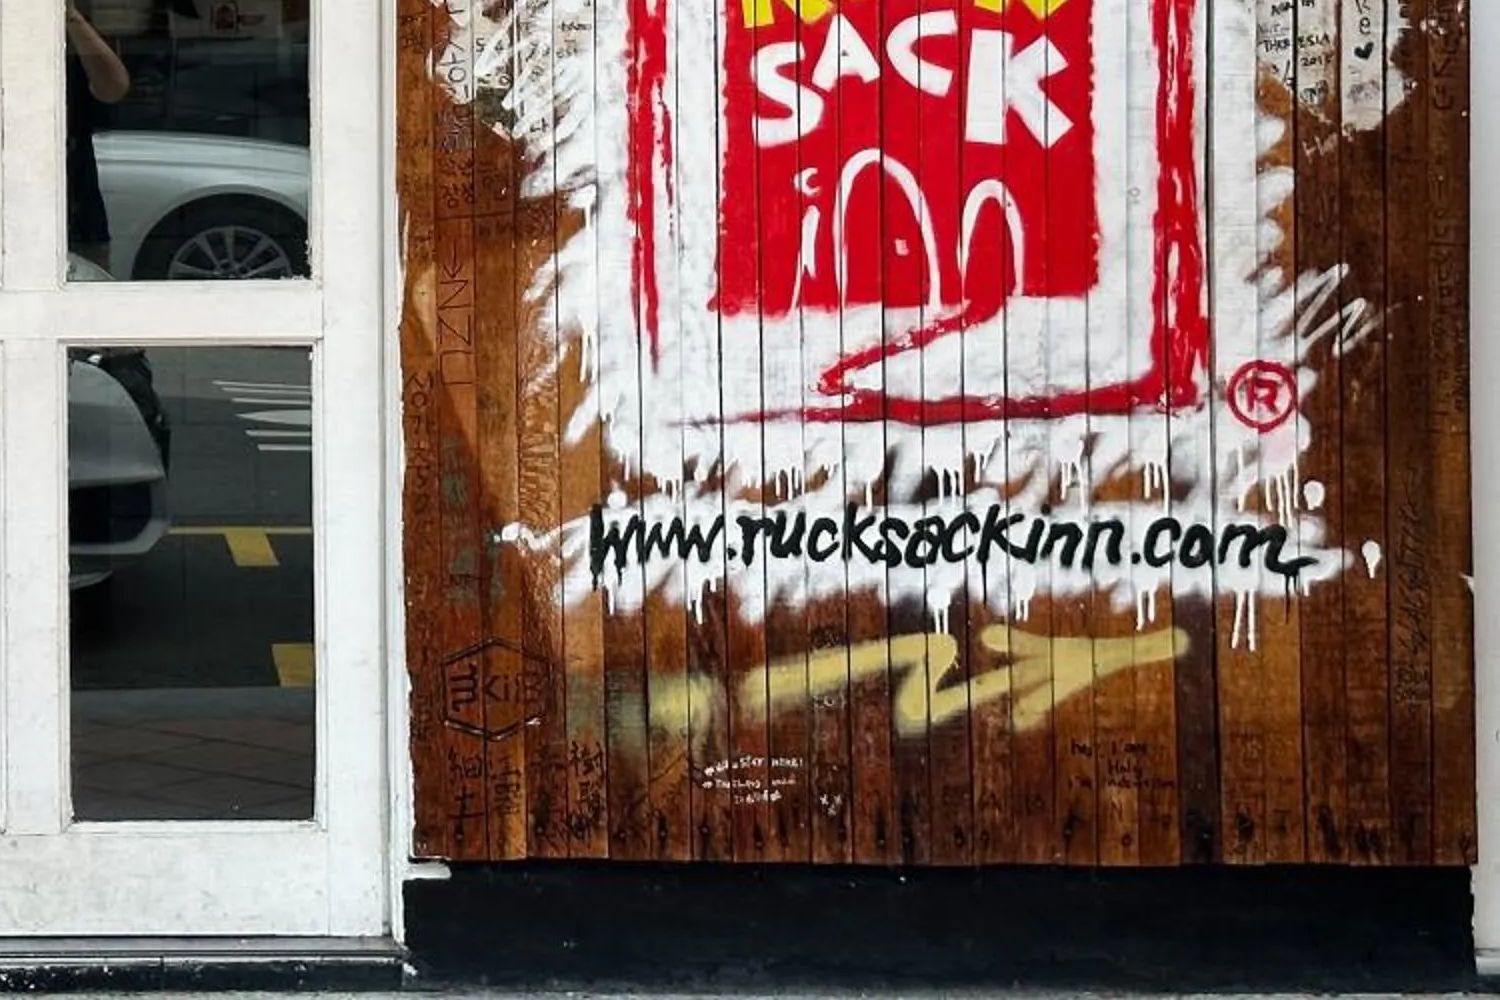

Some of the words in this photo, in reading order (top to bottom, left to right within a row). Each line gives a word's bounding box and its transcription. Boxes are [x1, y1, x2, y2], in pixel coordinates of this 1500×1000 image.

[751, 9, 1075, 149] SACK
[790, 148, 1026, 312] inn
[589, 502, 1318, 582] www.rucksackinn.com
